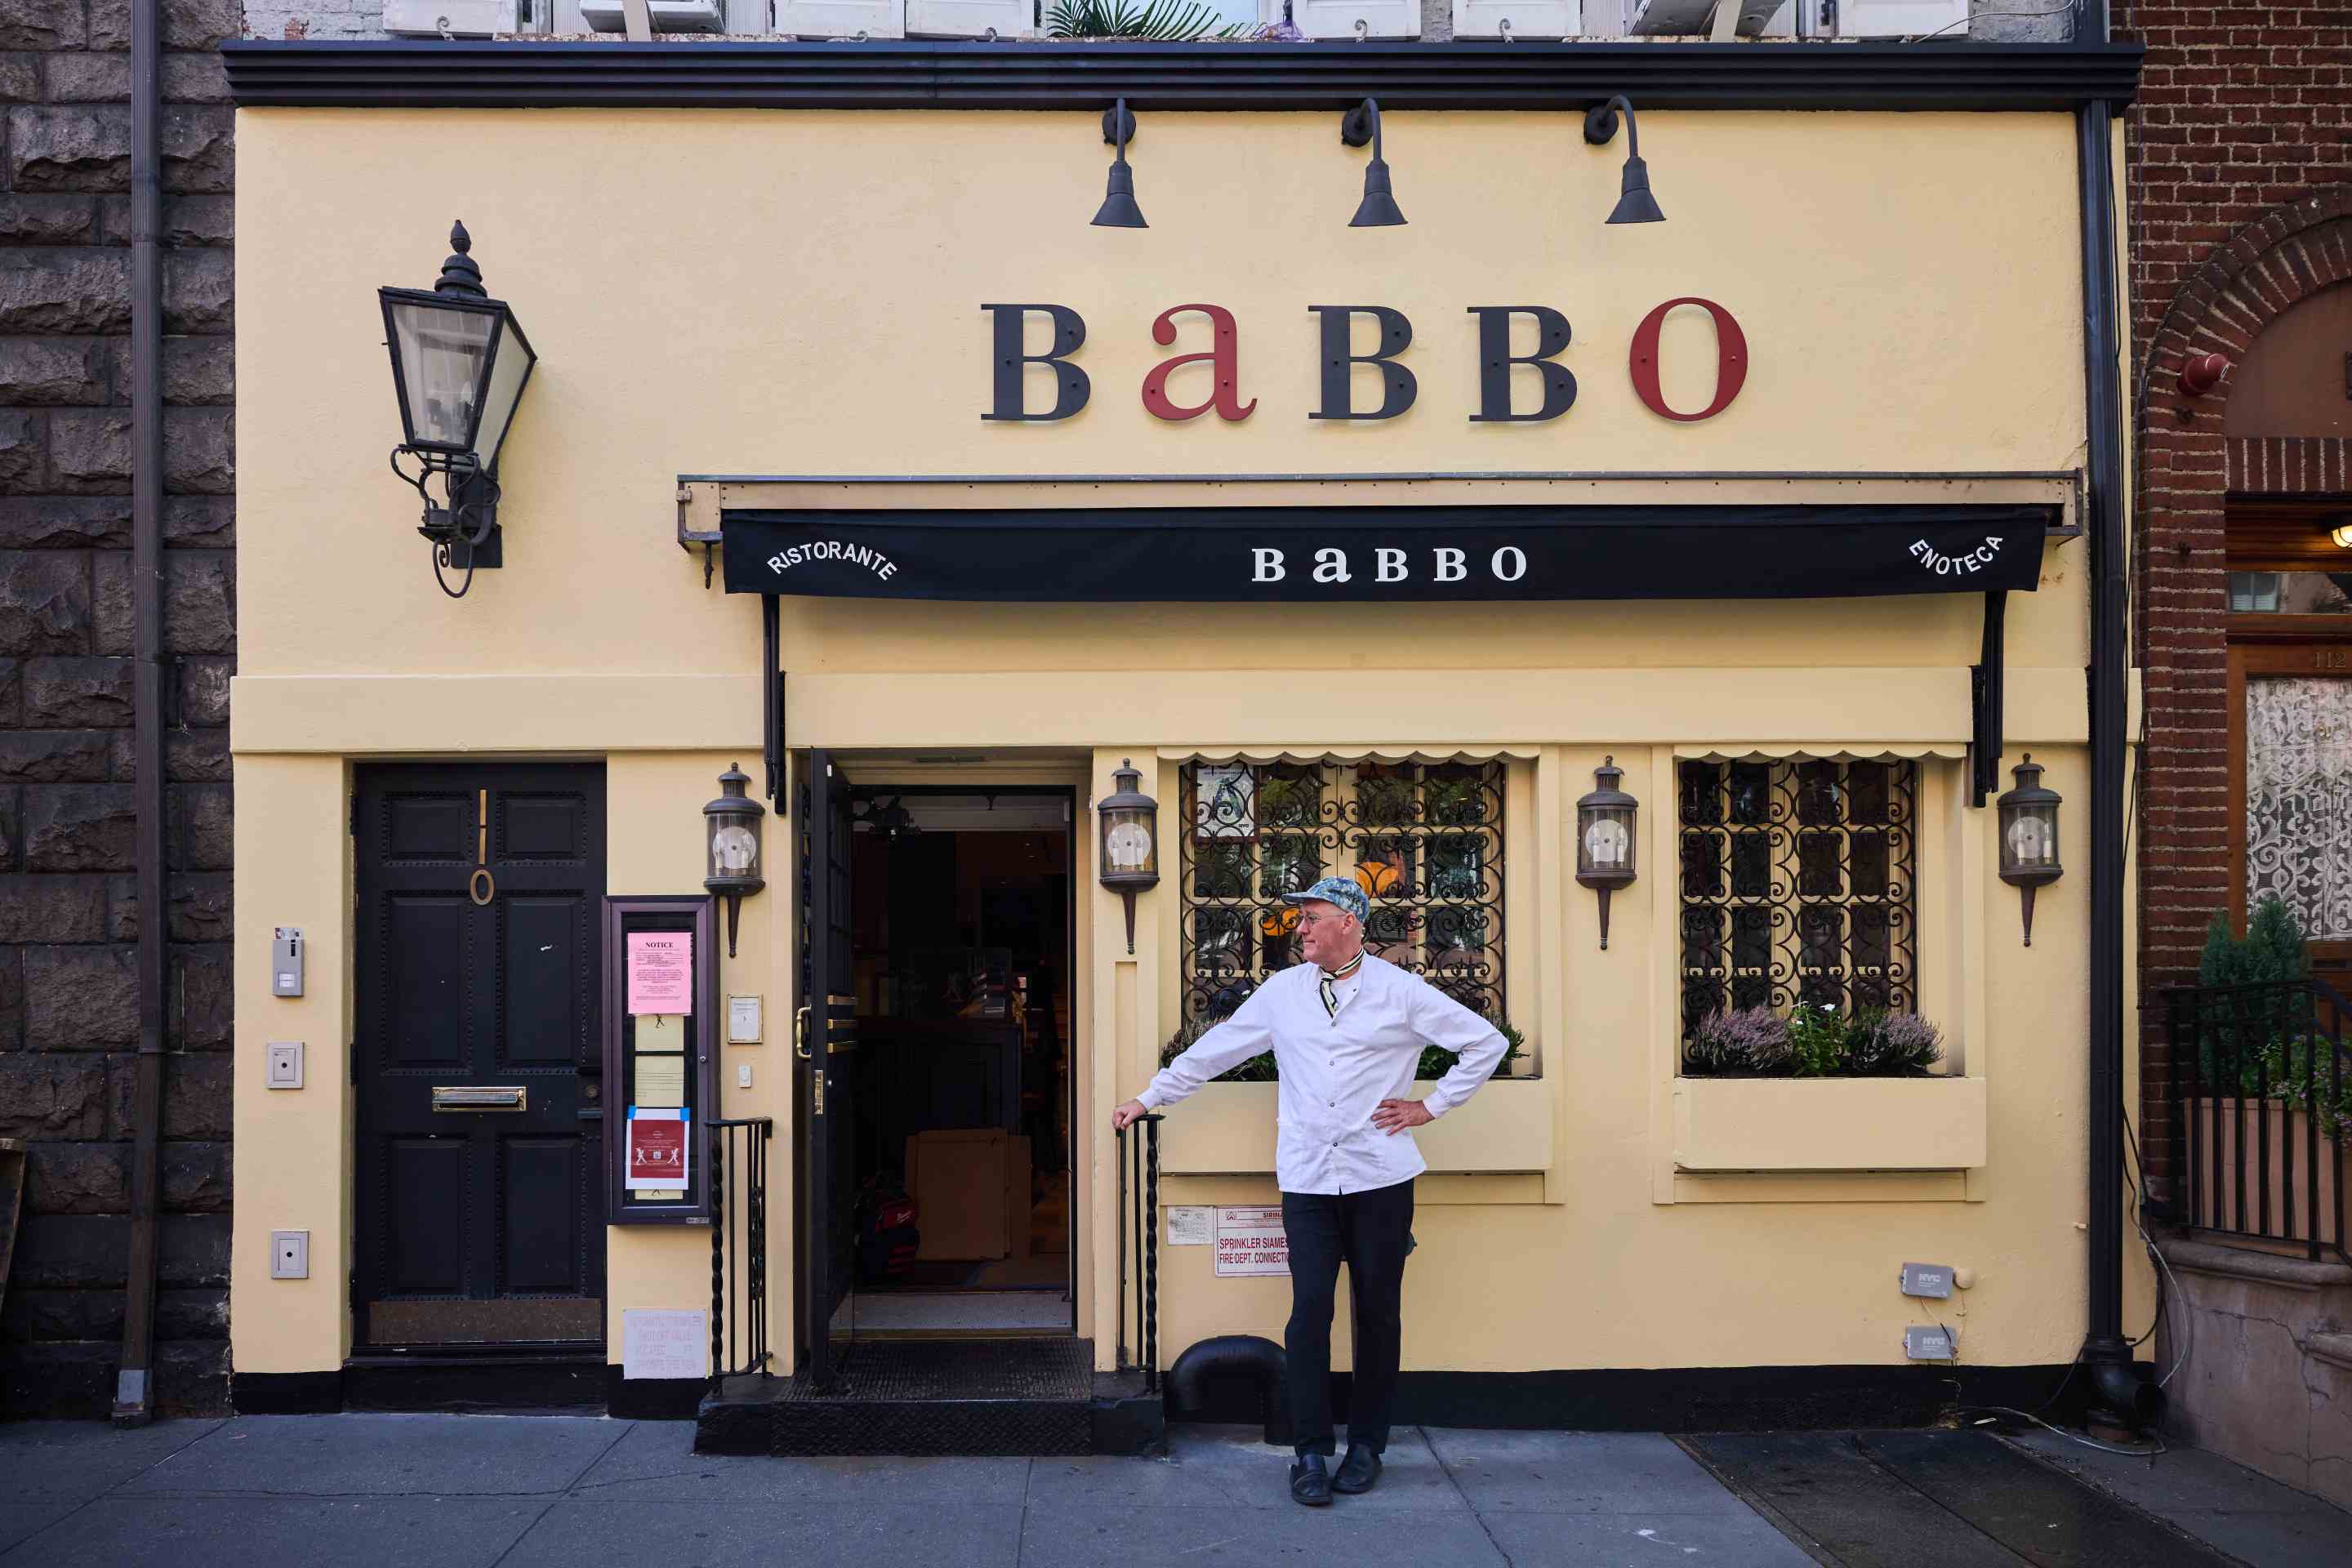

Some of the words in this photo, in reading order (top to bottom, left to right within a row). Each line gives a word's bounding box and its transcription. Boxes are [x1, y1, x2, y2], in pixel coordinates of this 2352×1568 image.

[766, 541, 898, 581] RISTORANTE
[1909, 536, 2004, 576] ENOTECA
[1219, 1237, 1261, 1250] SPRINKLER
[1219, 1253, 1234, 1264] FIRE
[1235, 1252, 1254, 1263] DEPT.
[1918, 1273, 1941, 1283] NYC
[1922, 1337, 1945, 1345] NYC
